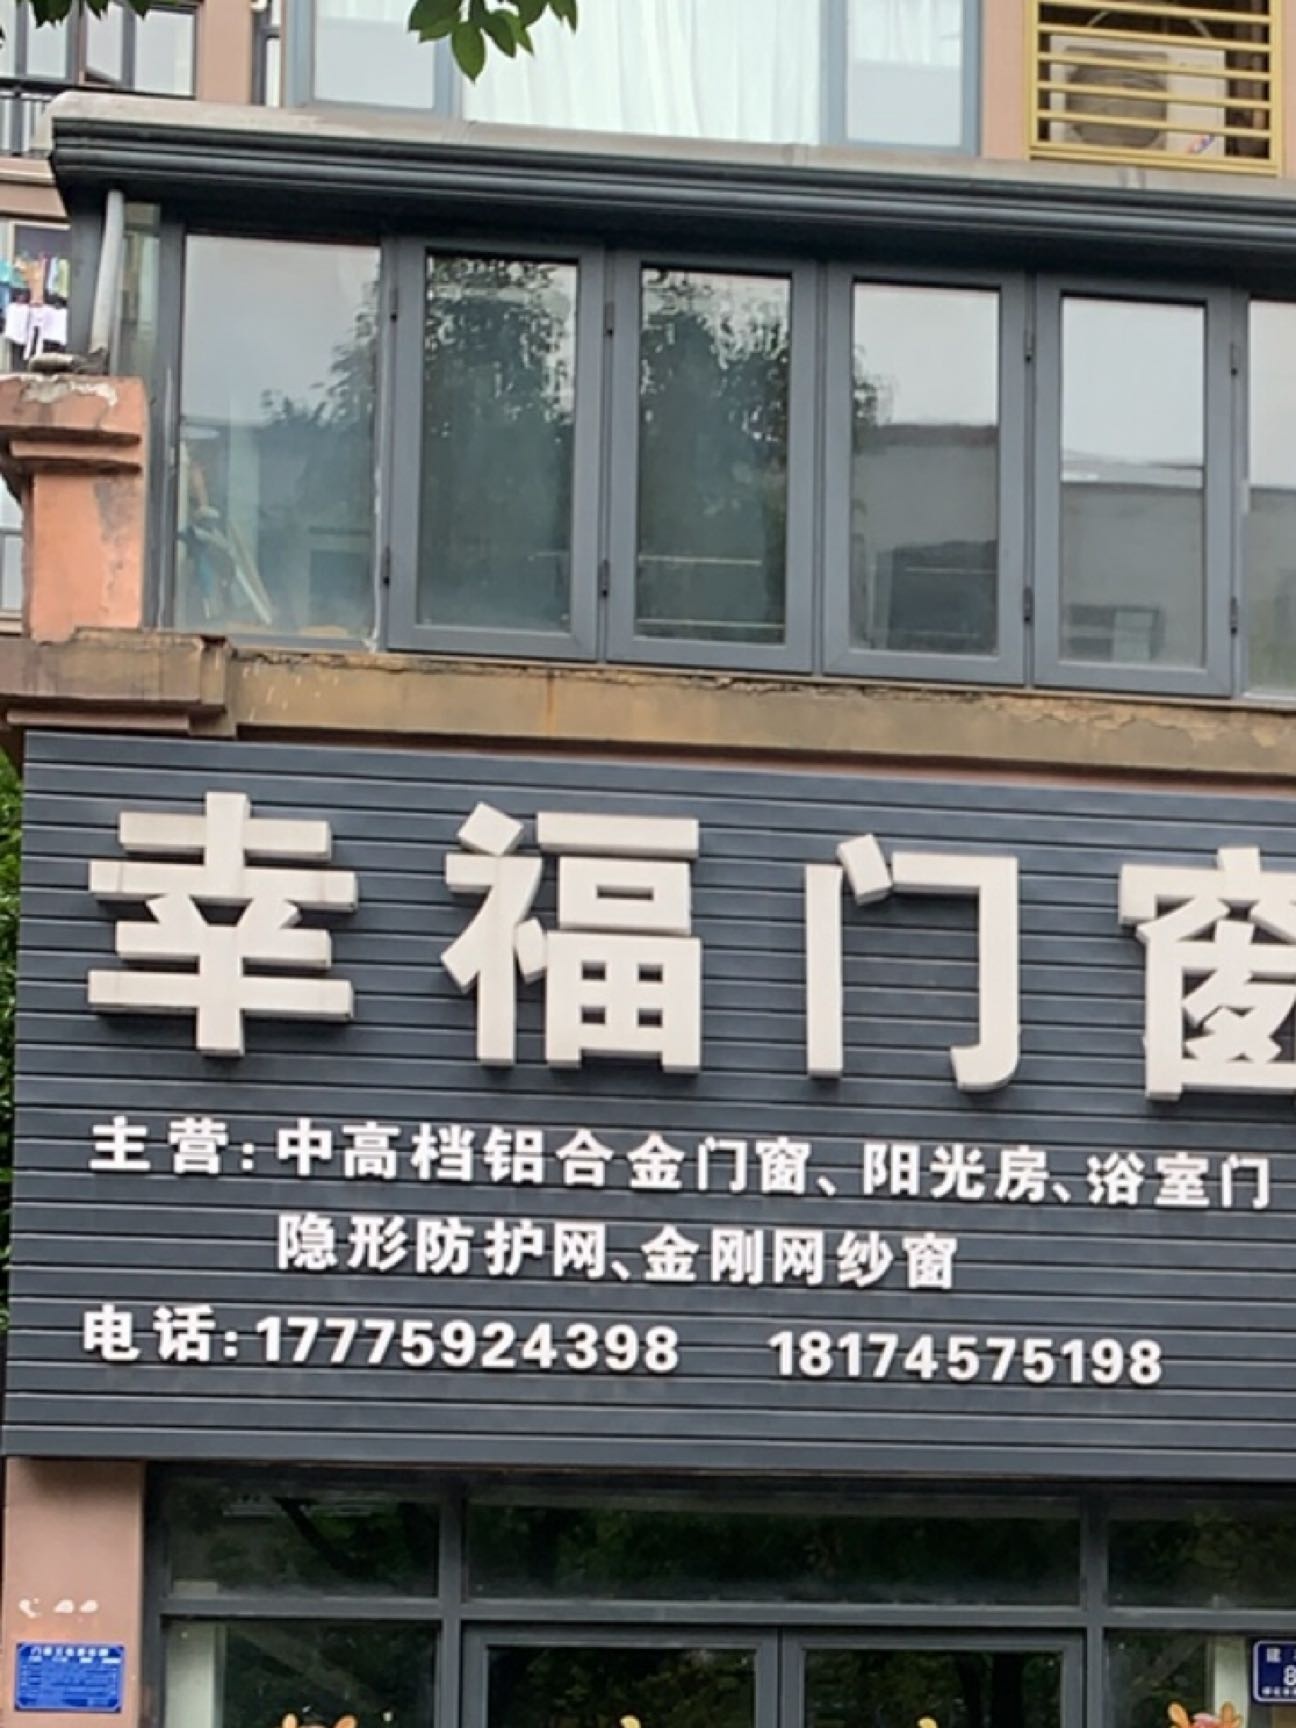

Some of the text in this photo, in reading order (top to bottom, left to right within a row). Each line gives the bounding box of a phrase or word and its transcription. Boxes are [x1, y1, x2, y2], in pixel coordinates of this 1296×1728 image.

[276, 1211, 958, 1290] 隐形防护网、金刚网纱窗
[768, 1329, 1163, 1386] 18174575198
